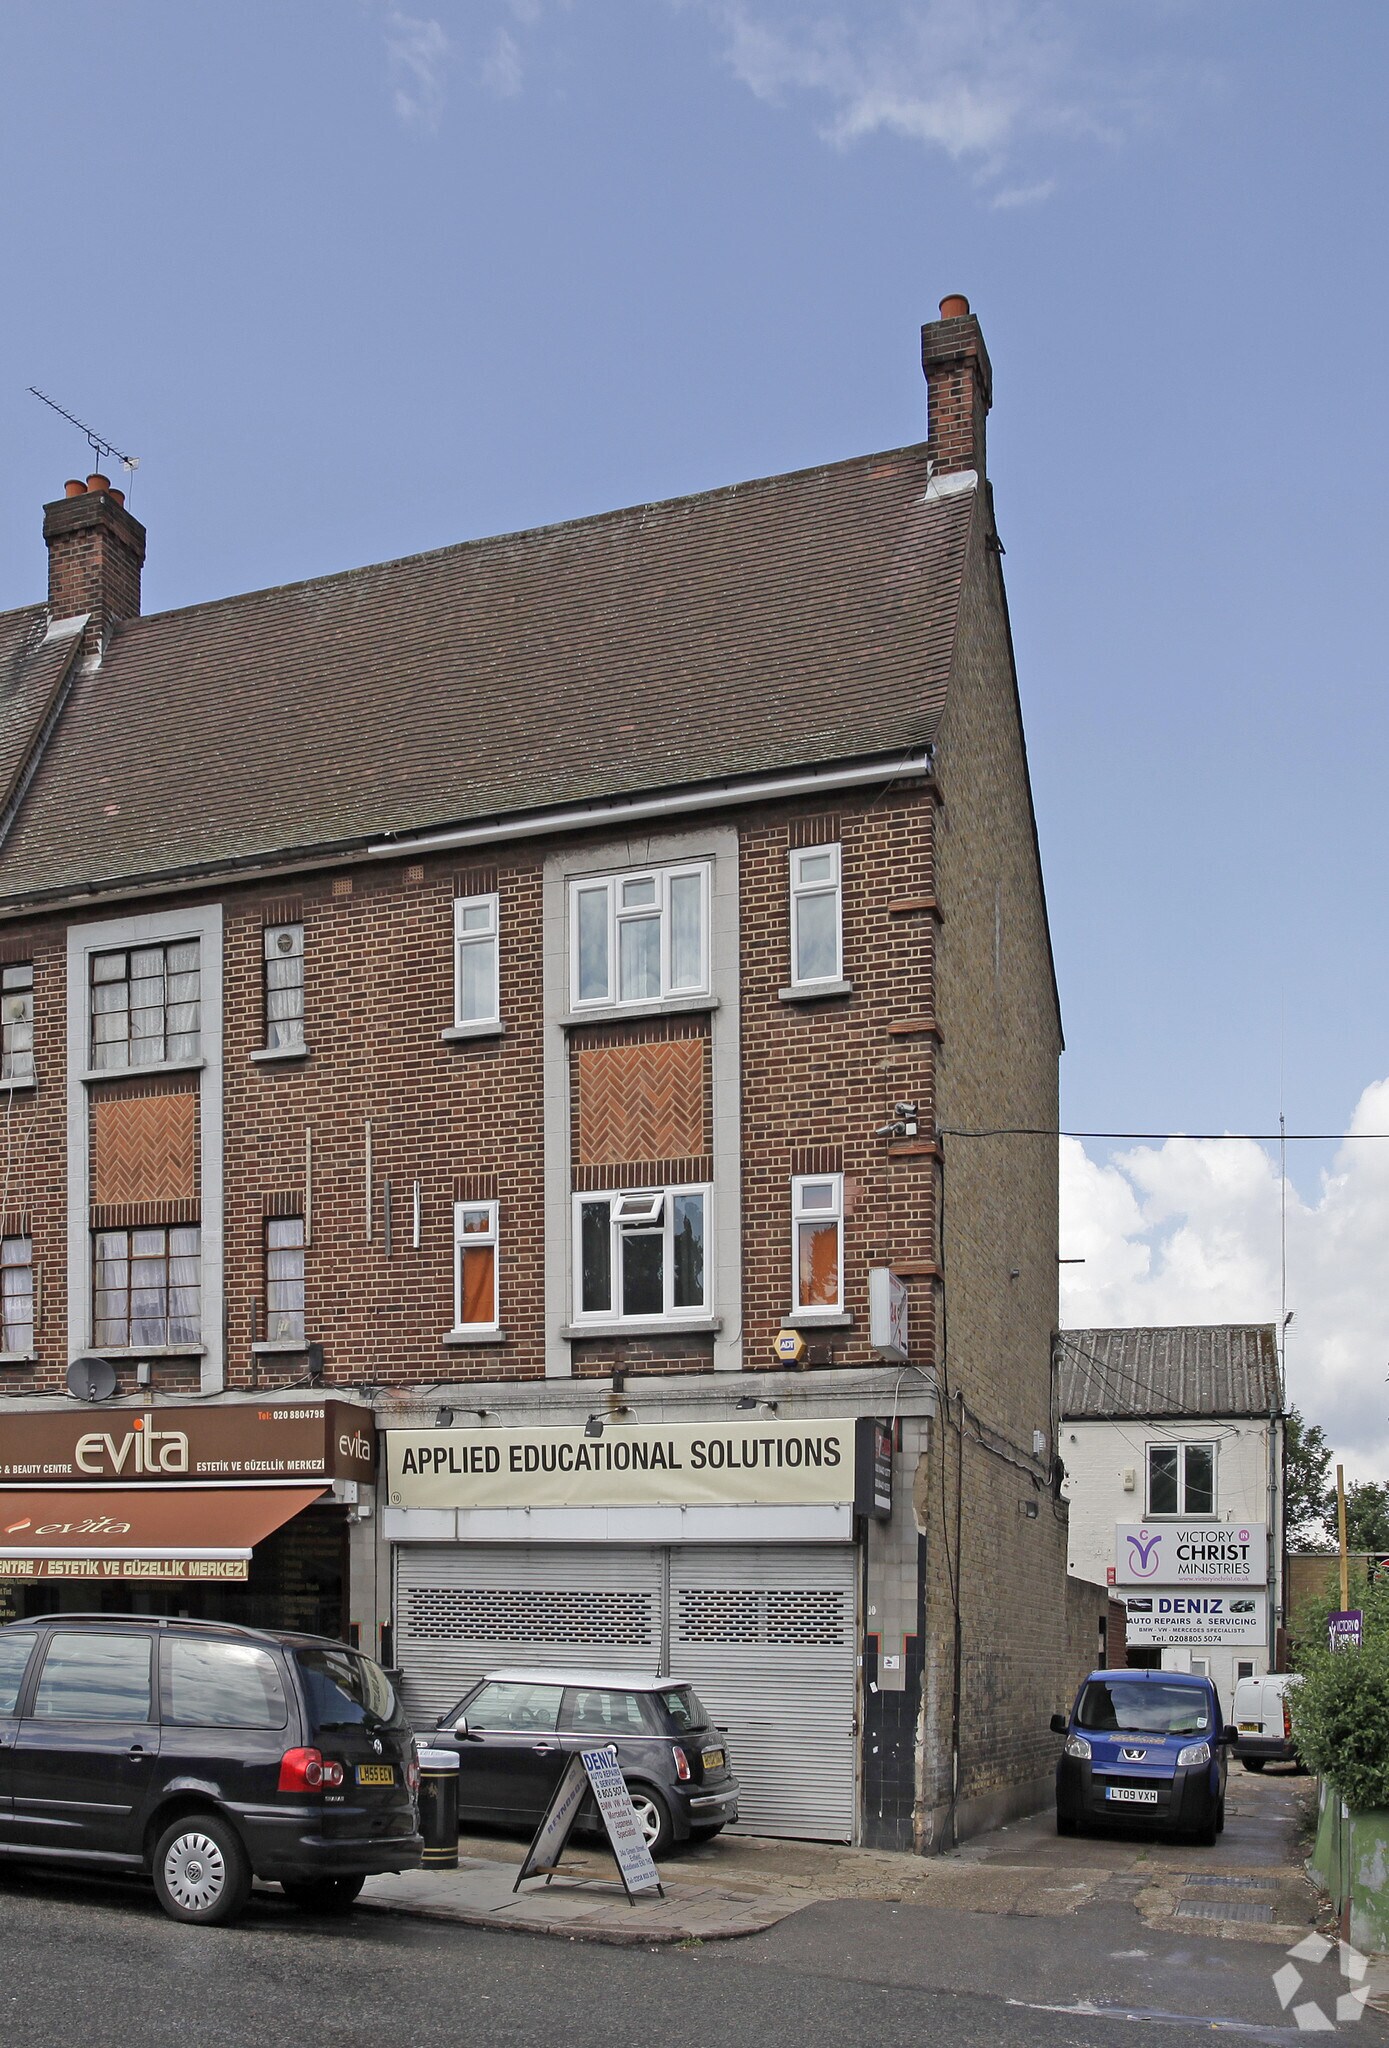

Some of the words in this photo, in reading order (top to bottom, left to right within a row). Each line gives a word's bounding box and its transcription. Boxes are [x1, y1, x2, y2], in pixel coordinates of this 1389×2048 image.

[779, 1340, 795, 1350] ADT
[258, 1411, 272, 1420] Tel:
[273, 1410, 289, 1420] 020
[75, 1413, 189, 1474] evita
[339, 1429, 371, 1461] evita
[401, 1445, 501, 1475] APPLIED
[509, 1441, 682, 1473] EDUCATIONAL
[690, 1436, 842, 1469] SOLUTIONS
[4, 1464, 11, 1474] &
[12, 1464, 42, 1474] BEAUTY
[43, 1463, 73, 1474] CENTRE
[230, 1460, 242, 1472] VE
[35, 1516, 131, 1535] evita
[1176, 1531, 1234, 1543] VICTORY
[1176, 1544, 1250, 1560] CHRIST
[102, 1561, 121, 1575] VE
[1177, 1562, 1251, 1575] MINISTRIES
[1158, 1598, 1223, 1614] DENIZ
[1129, 1617, 1152, 1625] AUTO
[1154, 1617, 1191, 1625] REPAIRS
[1196, 1617, 1203, 1625] &
[1208, 1617, 1257, 1626] SERVICING
[1336, 1619, 1354, 1632] VICTORY
[583, 1750, 618, 1772] DENIZ
[603, 1768, 621, 1778] REPAIRS
[1110, 1788, 1136, 1800] LT09
[1138, 1790, 1156, 1801] VXH
